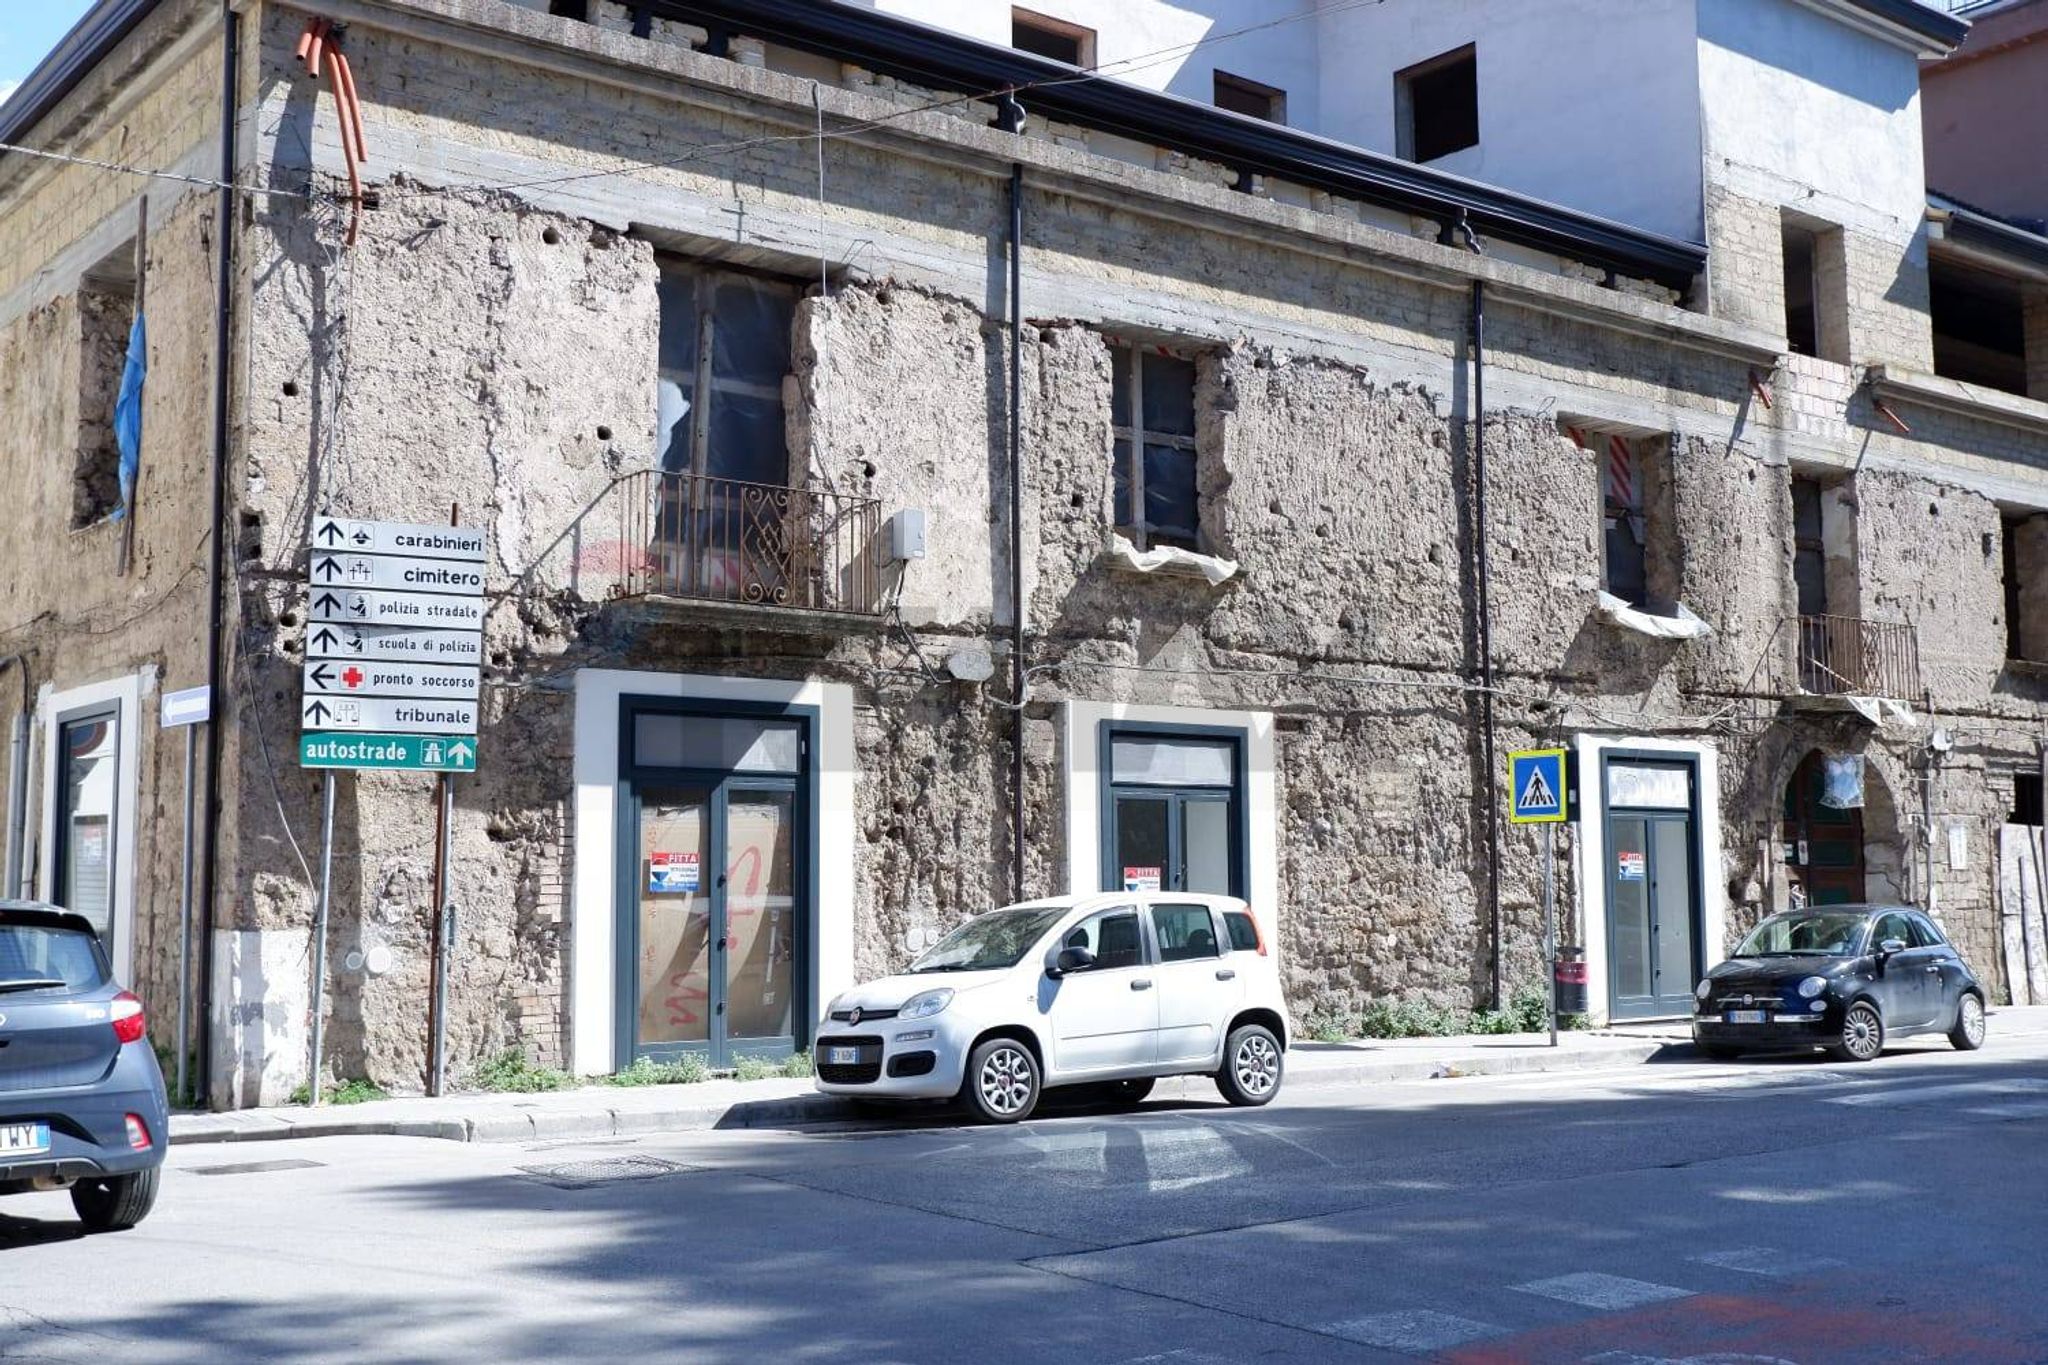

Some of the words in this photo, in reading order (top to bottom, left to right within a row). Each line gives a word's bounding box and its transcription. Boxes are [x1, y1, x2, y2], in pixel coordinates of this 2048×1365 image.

[395, 534, 482, 551] carabinieri
[404, 567, 481, 586] cimitero
[379, 601, 419, 615] polizia
[427, 603, 478, 618] stradale
[378, 637, 416, 651] scuola
[423, 638, 434, 651] di
[439, 640, 477, 654] polizia
[373, 672, 414, 687] pronto
[421, 674, 475, 688] soccorso
[395, 707, 471, 724] tribunale
[306, 740, 408, 761] autostrade
